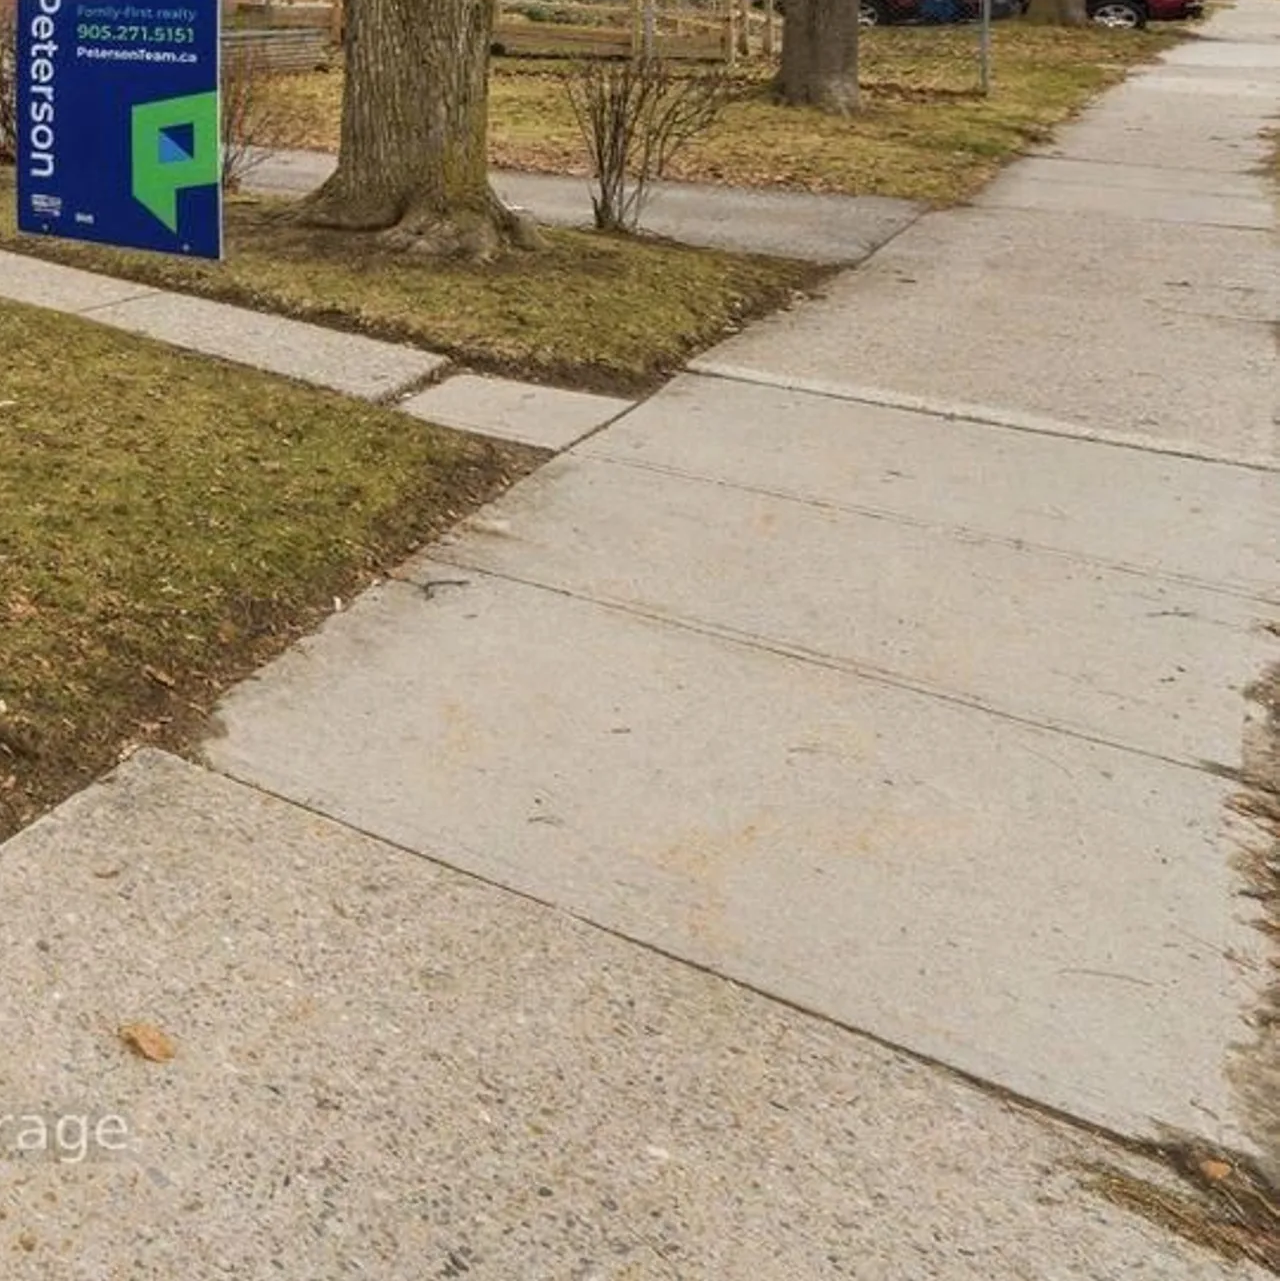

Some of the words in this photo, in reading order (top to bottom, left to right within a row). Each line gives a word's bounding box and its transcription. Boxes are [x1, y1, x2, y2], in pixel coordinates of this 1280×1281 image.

[157, 7, 197, 22] realty
[76, 23, 195, 43] 905.271.5151
[76, 46, 198, 63] PetersonTeam.ca
